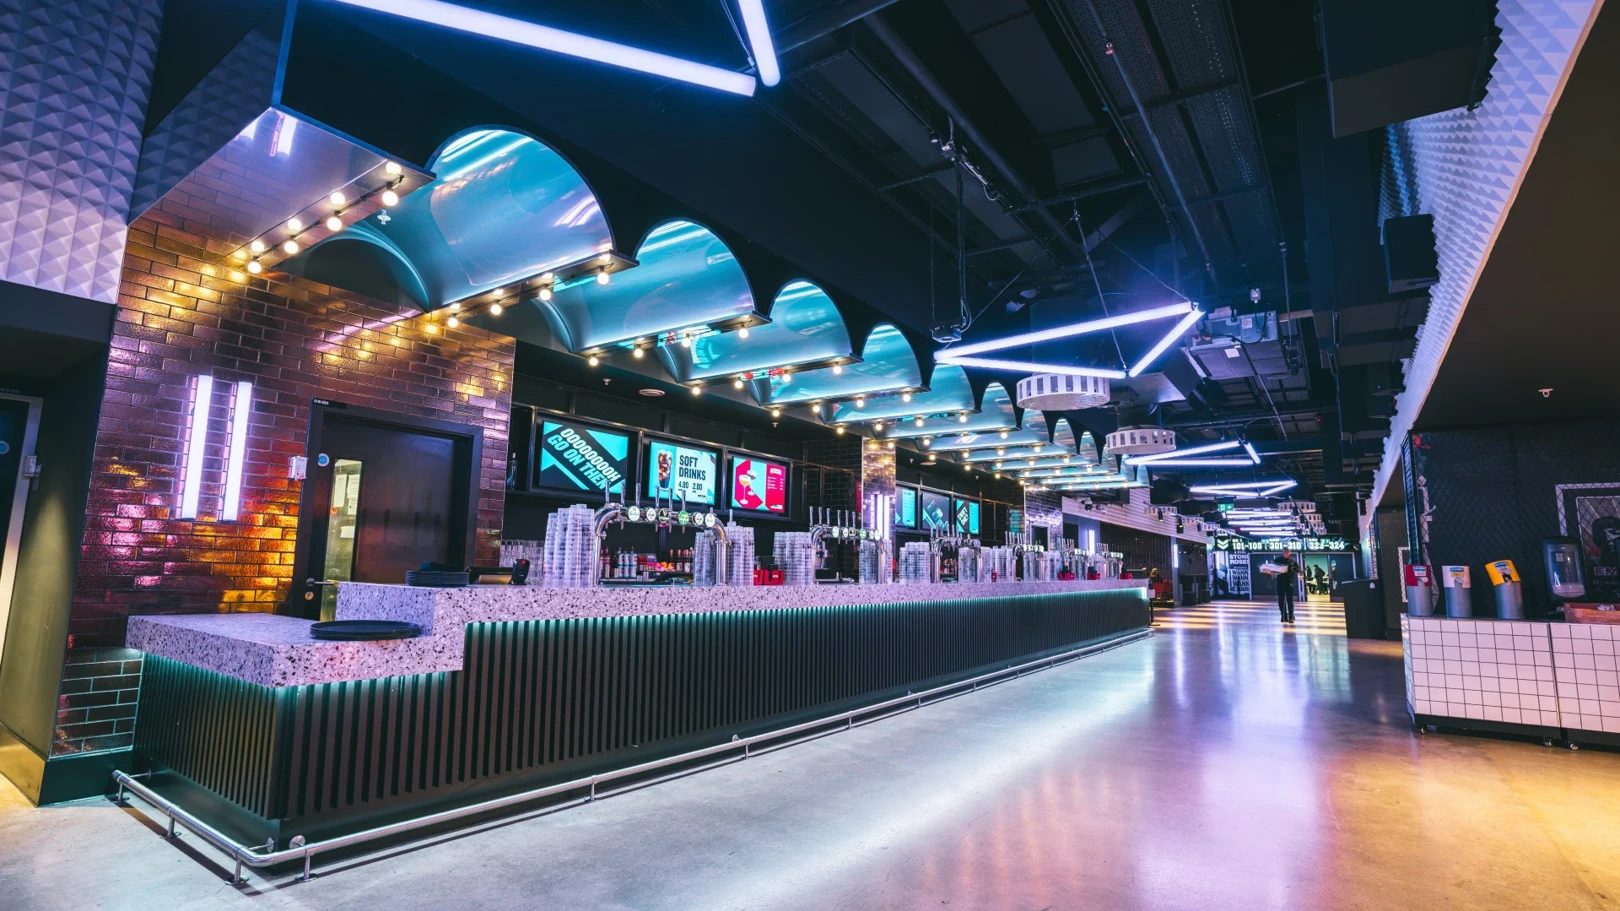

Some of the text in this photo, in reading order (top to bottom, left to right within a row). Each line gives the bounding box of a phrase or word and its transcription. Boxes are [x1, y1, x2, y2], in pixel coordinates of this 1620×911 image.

[547, 434, 609, 490] GO ON THEN
[560, 428, 621, 482] OOOOOOOOH
[679, 455, 698, 467] SOFT
[678, 467, 706, 480] DRINKS
